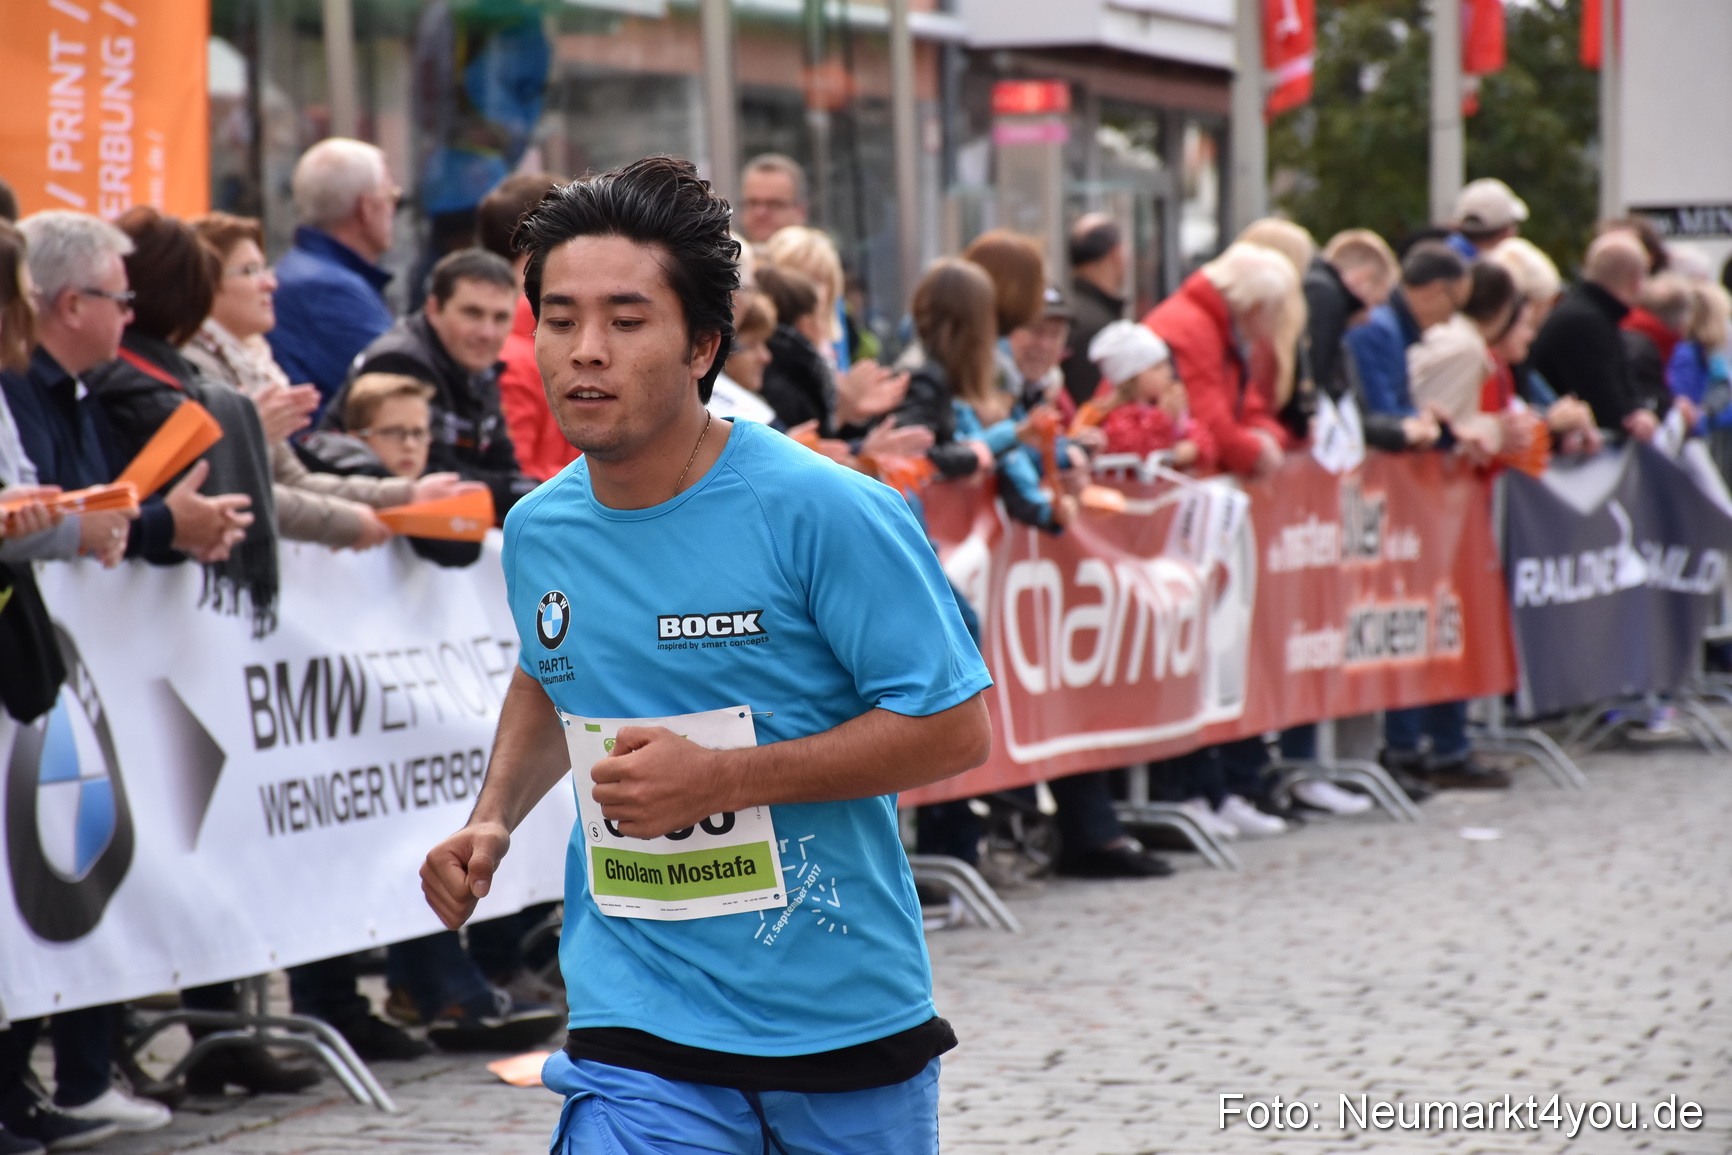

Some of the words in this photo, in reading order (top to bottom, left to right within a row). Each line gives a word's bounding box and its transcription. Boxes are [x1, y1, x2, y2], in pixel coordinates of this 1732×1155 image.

[48, 30, 86, 173] PRINT
[98, 36, 136, 221] ERBUNG
[539, 593, 568, 613] BMW
[659, 613, 761, 638] BOCK
[657, 641, 688, 651] inspired
[689, 641, 699, 650] by
[701, 640, 727, 648] smart
[729, 636, 770, 647] concepts
[538, 656, 574, 675] PARTL
[540, 671, 576, 686] Neumarkt
[243, 655, 368, 751] BMW
[364, 635, 513, 732] EFFICIE
[258, 765, 389, 838] WENIGER
[389, 747, 486, 813] VERBR
[605, 858, 664, 885] Gholam
[667, 855, 757, 885] Mostafa
[763, 933, 777, 946] 17.
[772, 886, 808, 934] September
[804, 864, 822, 889] 2017
